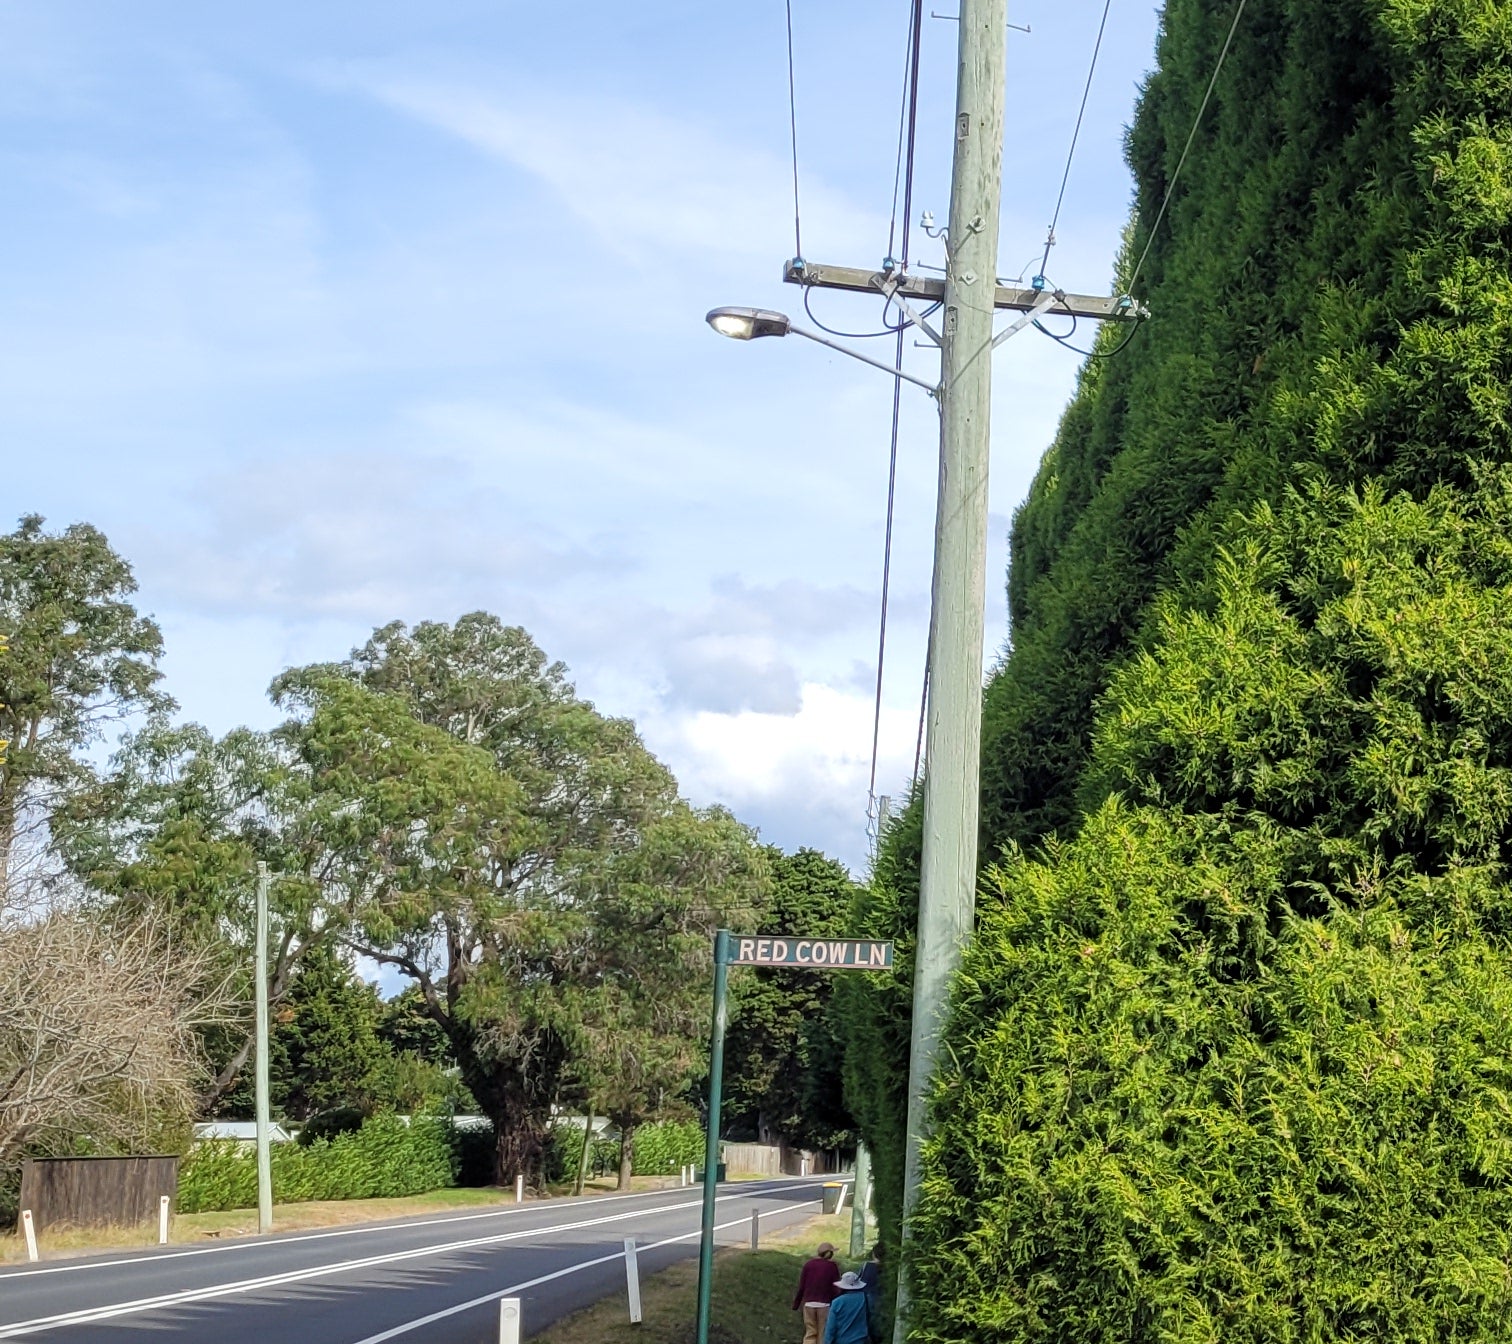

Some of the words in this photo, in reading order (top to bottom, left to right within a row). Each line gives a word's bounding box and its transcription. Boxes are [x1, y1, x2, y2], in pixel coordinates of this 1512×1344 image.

[739, 939, 788, 961] RED
[796, 941, 847, 963] COW
[854, 943, 886, 965] LN
